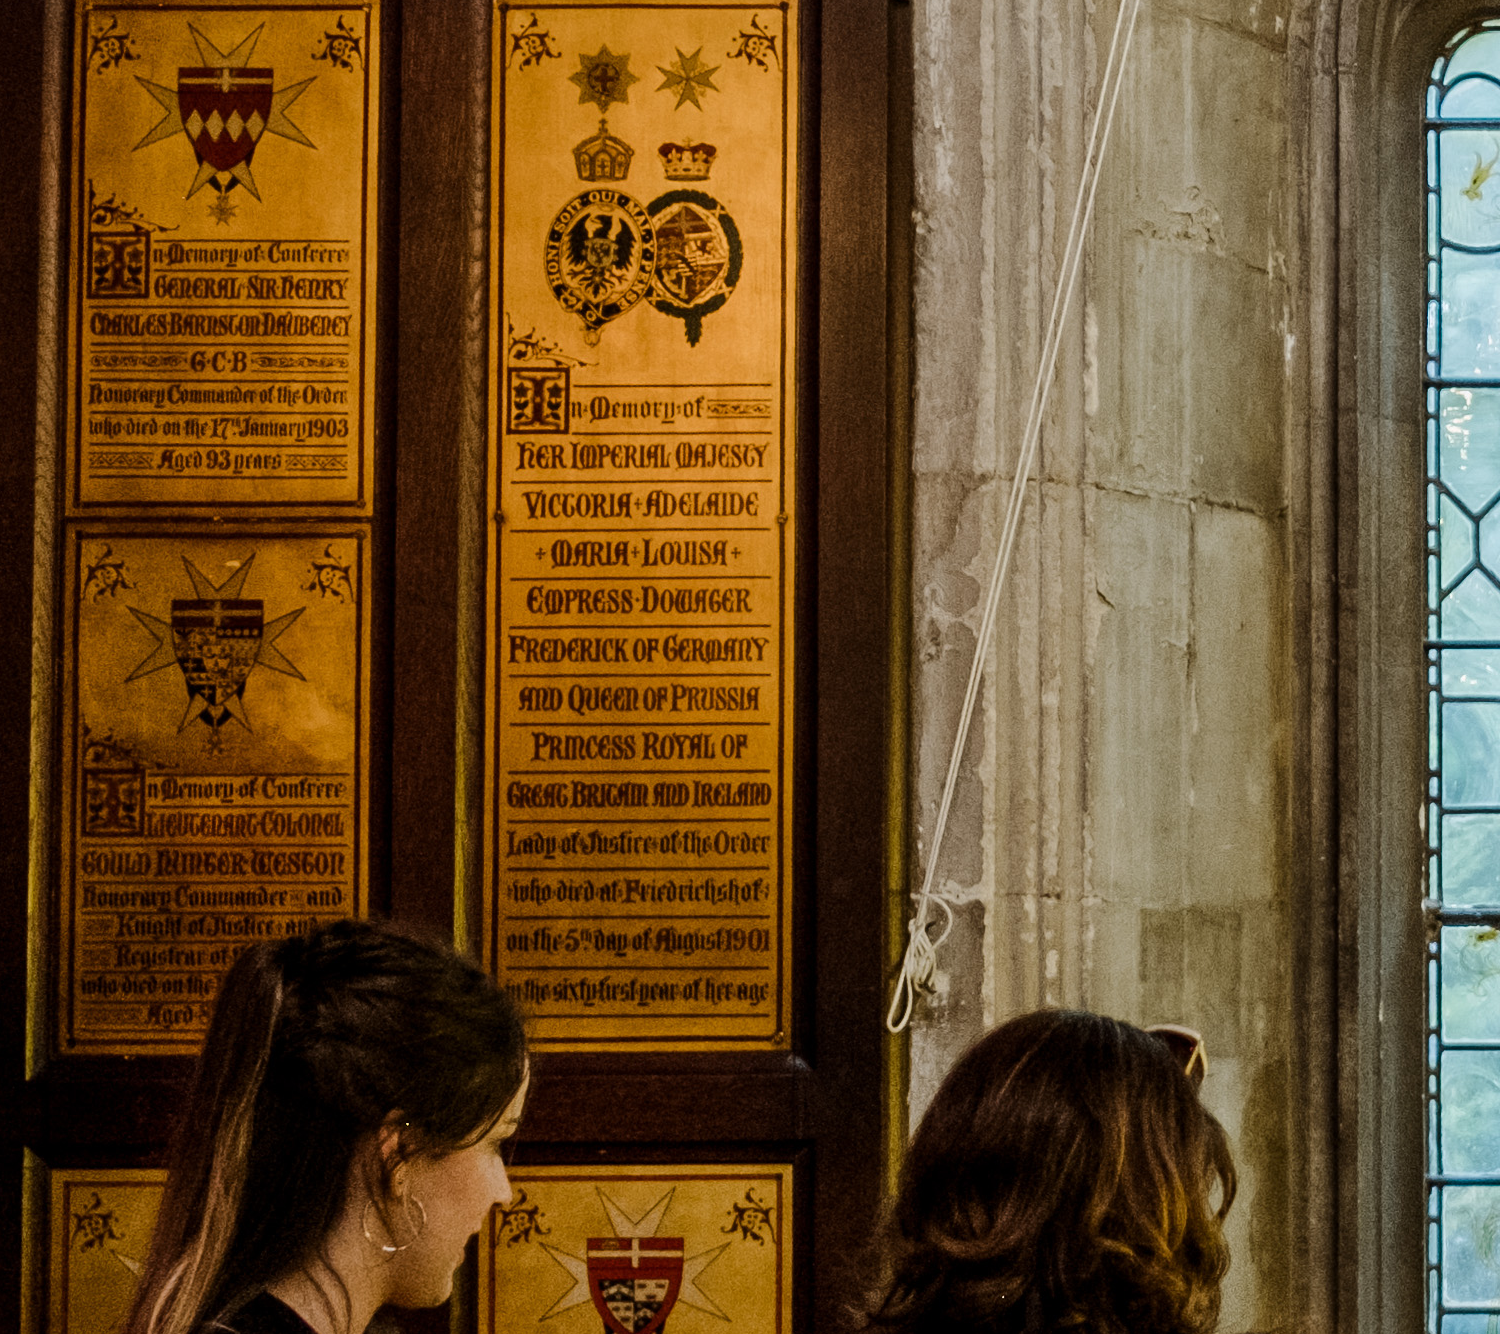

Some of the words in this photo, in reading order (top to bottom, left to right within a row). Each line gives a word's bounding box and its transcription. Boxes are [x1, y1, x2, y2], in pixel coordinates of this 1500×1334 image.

[588, 191, 620, 204] QUI
[167, 244, 236, 267] Memory
[244, 244, 261, 263] of
[259, 384, 276, 404] of
[278, 384, 299, 406] the
[303, 384, 346, 404] Order
[589, 396, 675, 424] Memory
[683, 396, 705, 418] of
[89, 419, 121, 438] who
[126, 419, 157, 437] died
[163, 422, 180, 436] on
[185, 419, 208, 438] the
[240, 419, 306, 442] January
[306, 419, 348, 437] 1903
[206, 450, 230, 470] 93
[234, 453, 282, 473] years
[516, 442, 566, 470] HER
[570, 442, 672, 470] IMPERIAL
[674, 442, 769, 470] MAJESTY
[522, 490, 633, 518] VICTORIA
[643, 490, 759, 518] ADELAIDE
[551, 539, 629, 567] MARIA
[641, 539, 727, 567] LOUISA
[526, 586, 633, 614] EMPRESS
[639, 586, 752, 614] DOWAGER
[508, 635, 629, 663] FREDERICK
[633, 635, 659, 663] OF
[662, 635, 769, 663] GERMANY
[519, 685, 562, 711] AND
[568, 685, 638, 715] QUEEN
[644, 685, 668, 711] OF
[671, 685, 759, 711] PRUSSIA
[532, 732, 635, 760] PRINCESS
[642, 732, 715, 760] ROYAL
[721, 732, 747, 760] OF
[507, 781, 568, 807] GREAT
[571, 781, 647, 807] BRITAIN
[652, 781, 688, 807] AND
[692, 781, 771, 807] IRELAND
[507, 831, 555, 859] Lady
[561, 831, 580, 855] of
[582, 831, 652, 855] Justice
[659, 831, 680, 855] of
[683, 830, 710, 857] the
[713, 831, 769, 855] Order
[307, 885, 342, 908] and
[513, 879, 549, 904] who
[557, 879, 593, 902] died
[600, 881, 619, 902] at
[507, 934, 530, 952] on
[533, 928, 559, 954] the
[595, 929, 627, 957] day
[633, 928, 651, 952] of
[654, 928, 724, 956] August
[726, 928, 770, 952] 1901
[524, 979, 550, 1004] the
[640, 982, 678, 1006] year
[683, 978, 703, 1001] of
[706, 979, 732, 1003] her
[737, 983, 768, 1005] age
